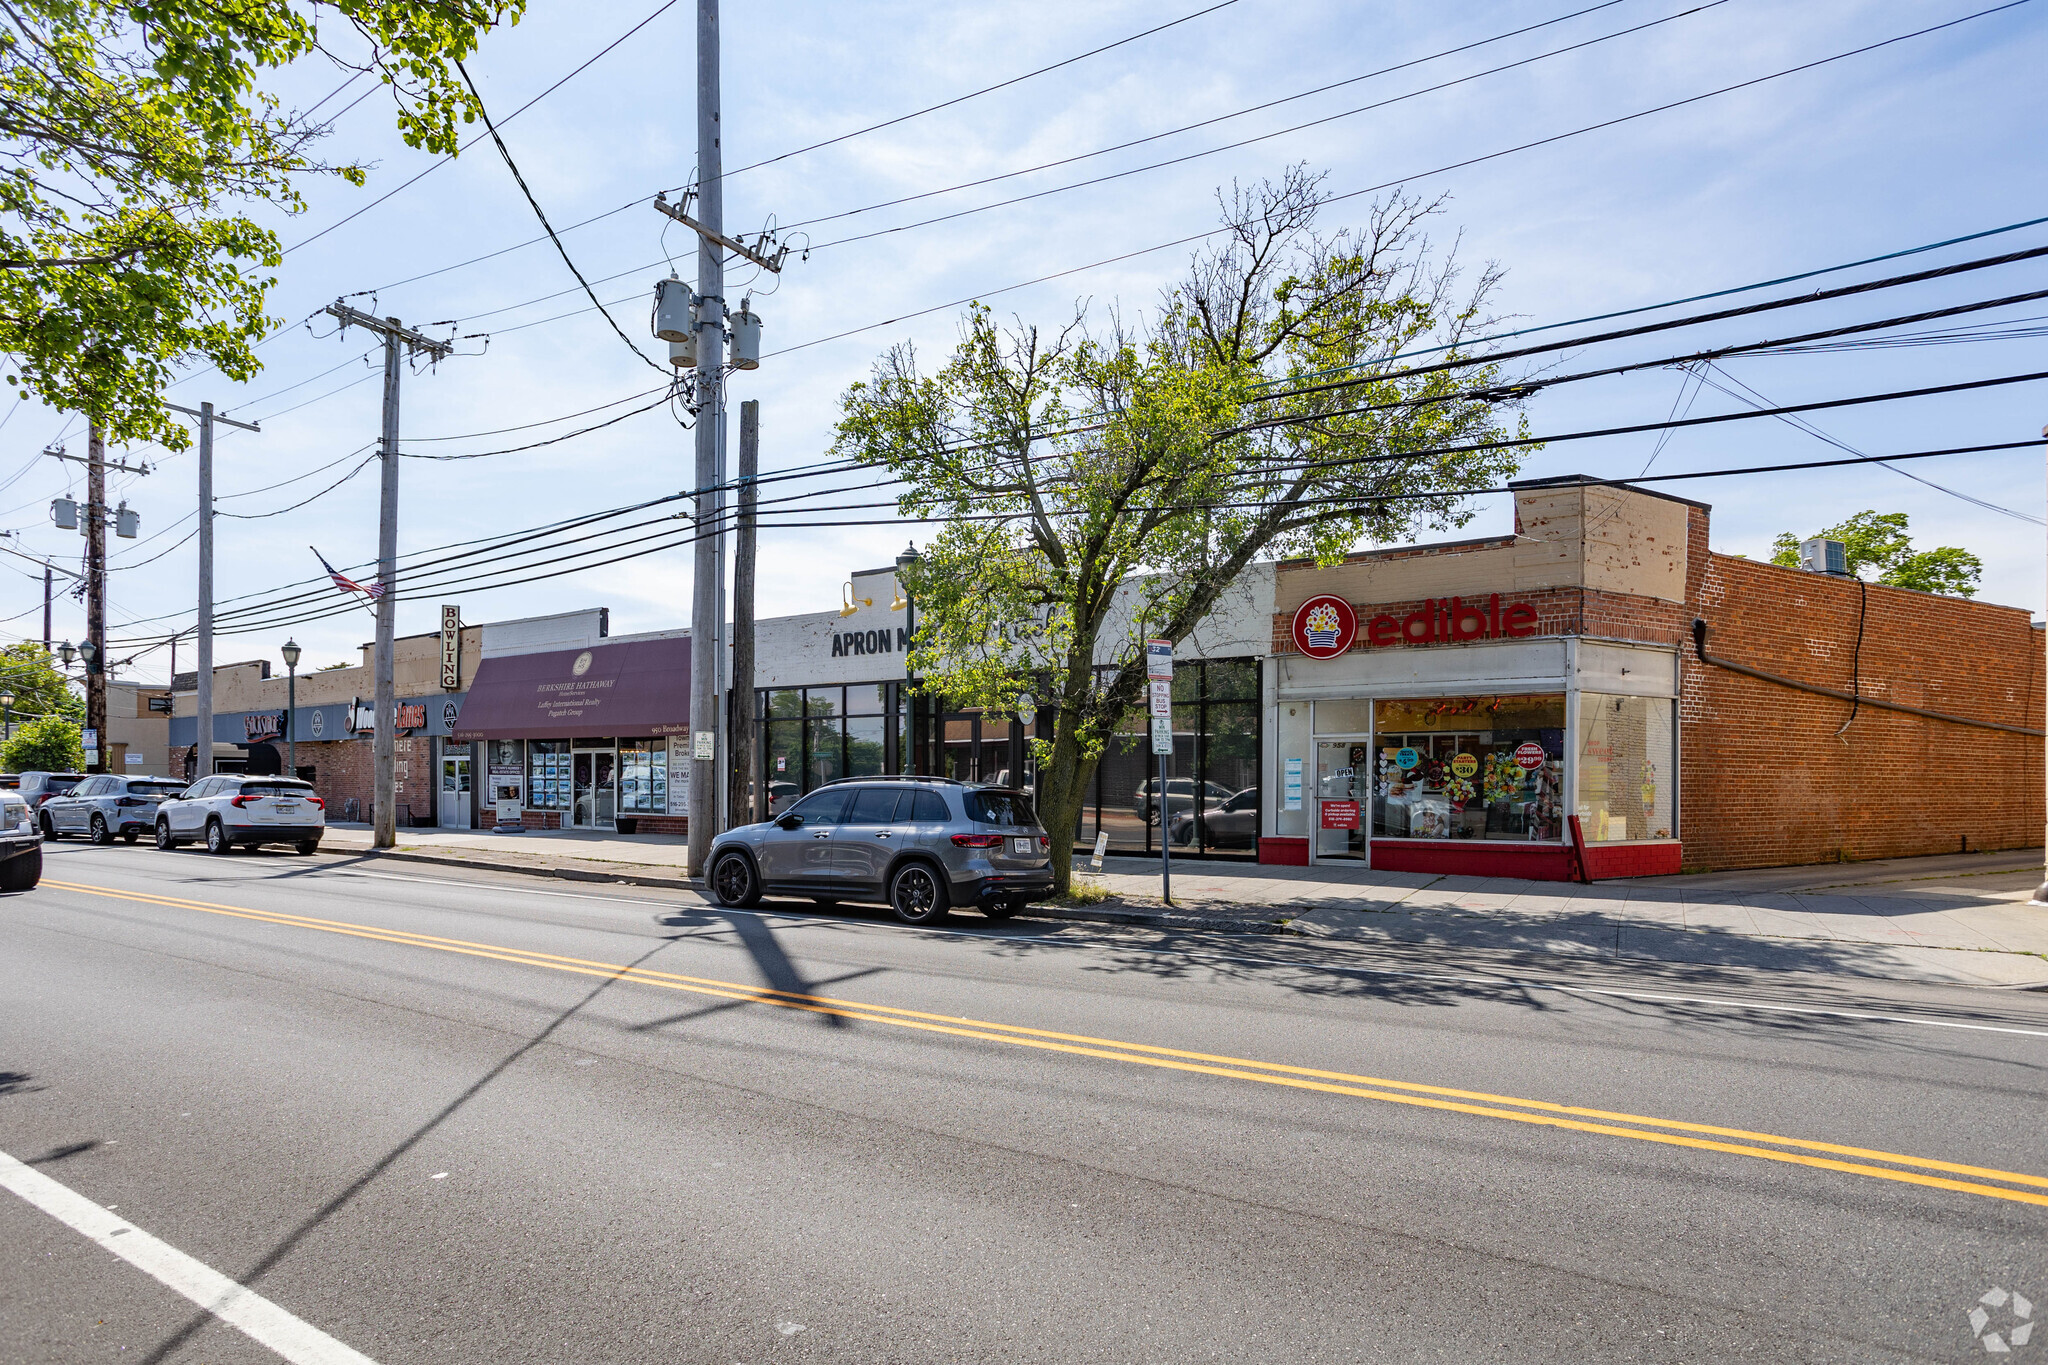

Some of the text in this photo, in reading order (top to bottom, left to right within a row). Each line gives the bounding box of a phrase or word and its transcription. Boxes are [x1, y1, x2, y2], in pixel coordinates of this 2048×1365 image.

[1368, 593, 1538, 646] edible
[444, 607, 456, 685] BOWLING
[831, 629, 892, 657] APRON
[537, 680, 616, 692] BERKSHIRE HATHAWAY
[1156, 684, 1164, 692] NO
[552, 699, 584, 708] International
[584, 698, 601, 707] Realty
[397, 702, 425, 728] Lanes
[567, 709, 583, 717] Group
[662, 724, 689, 734] Broadway
[1336, 768, 1353, 777] OPEN
[1455, 765, 1474, 774] $30
